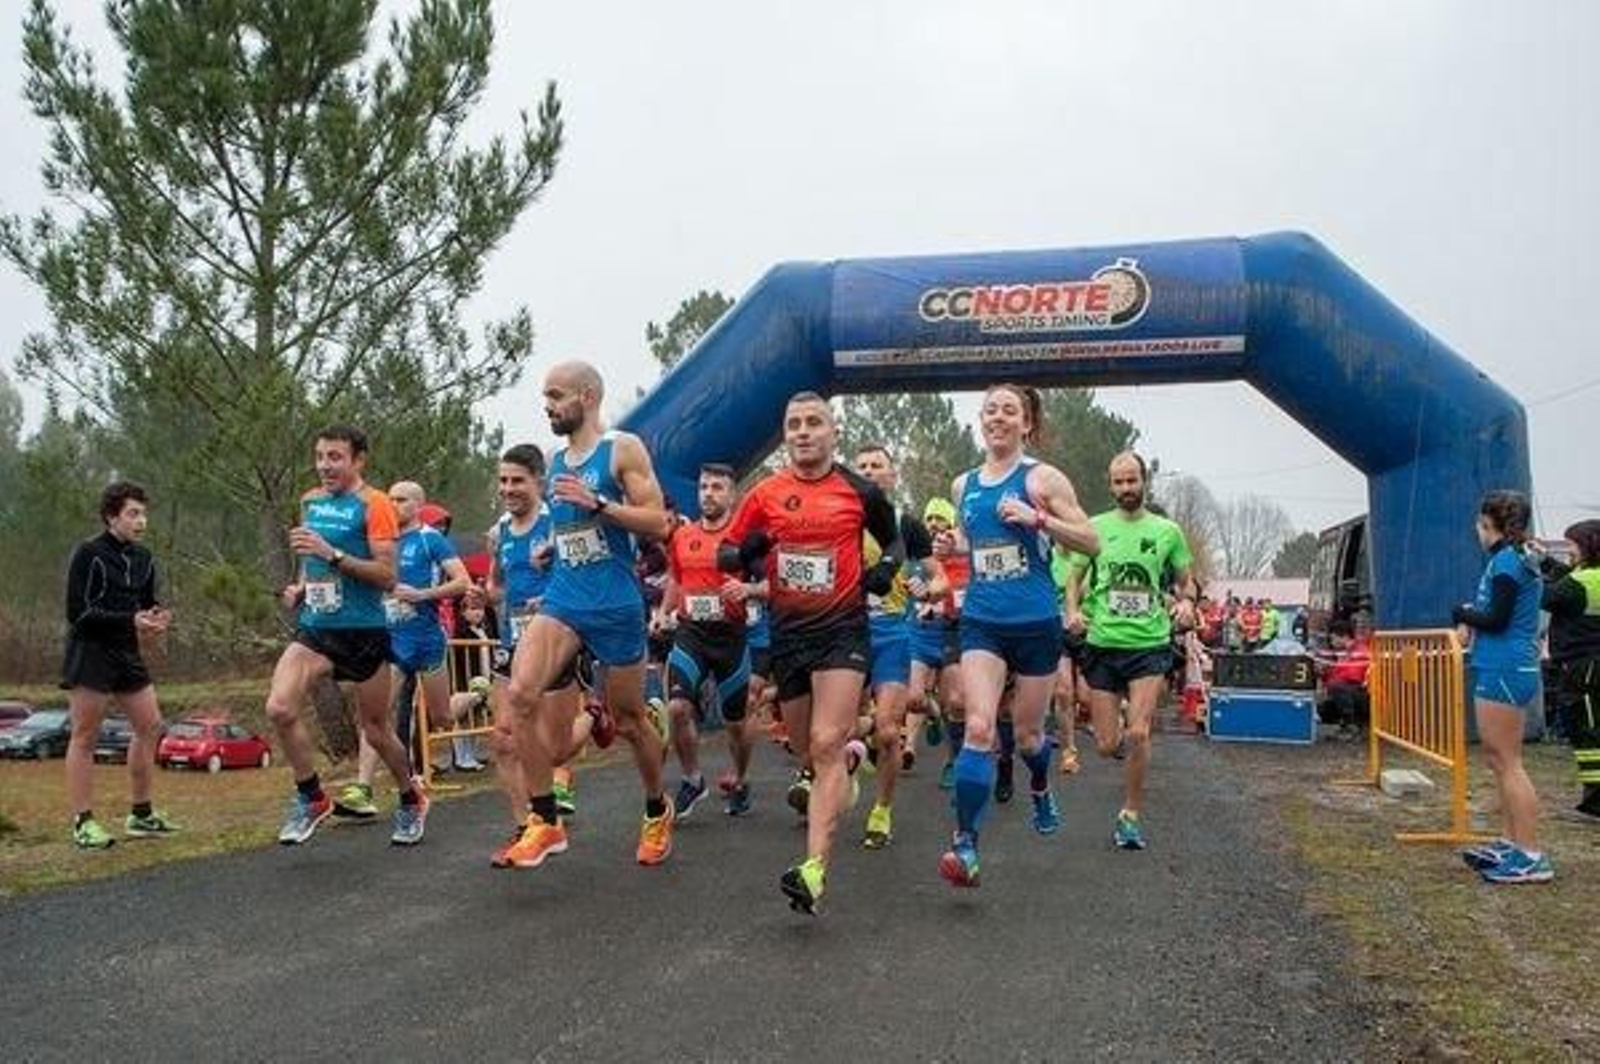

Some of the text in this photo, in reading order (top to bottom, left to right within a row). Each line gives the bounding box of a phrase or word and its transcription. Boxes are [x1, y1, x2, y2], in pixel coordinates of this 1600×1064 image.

[921, 284, 1110, 318] CCNORTE
[983, 314, 1107, 331] SPORTS TIMING
